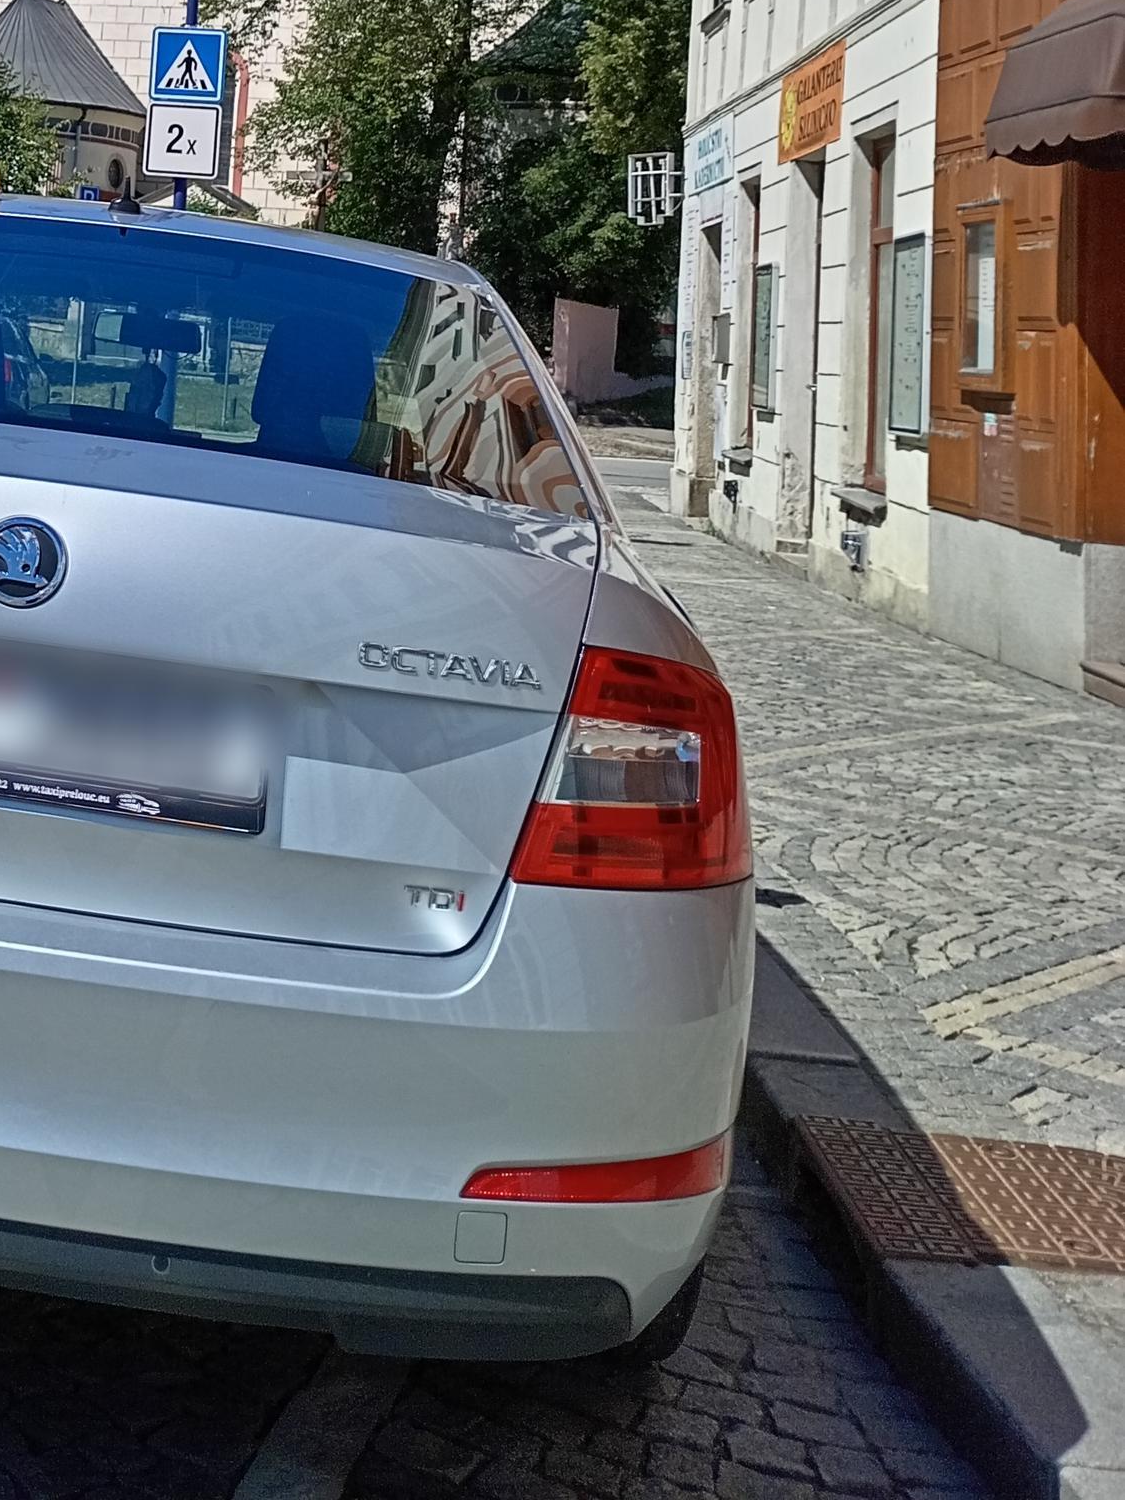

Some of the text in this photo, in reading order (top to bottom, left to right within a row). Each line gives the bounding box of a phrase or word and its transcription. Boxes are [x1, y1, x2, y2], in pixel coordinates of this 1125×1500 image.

[797, 55, 843, 106] GALANTERIE
[358, 641, 542, 690] OCTAVIA
[13, 781, 111, 804] www.taxiprelouc.eu
